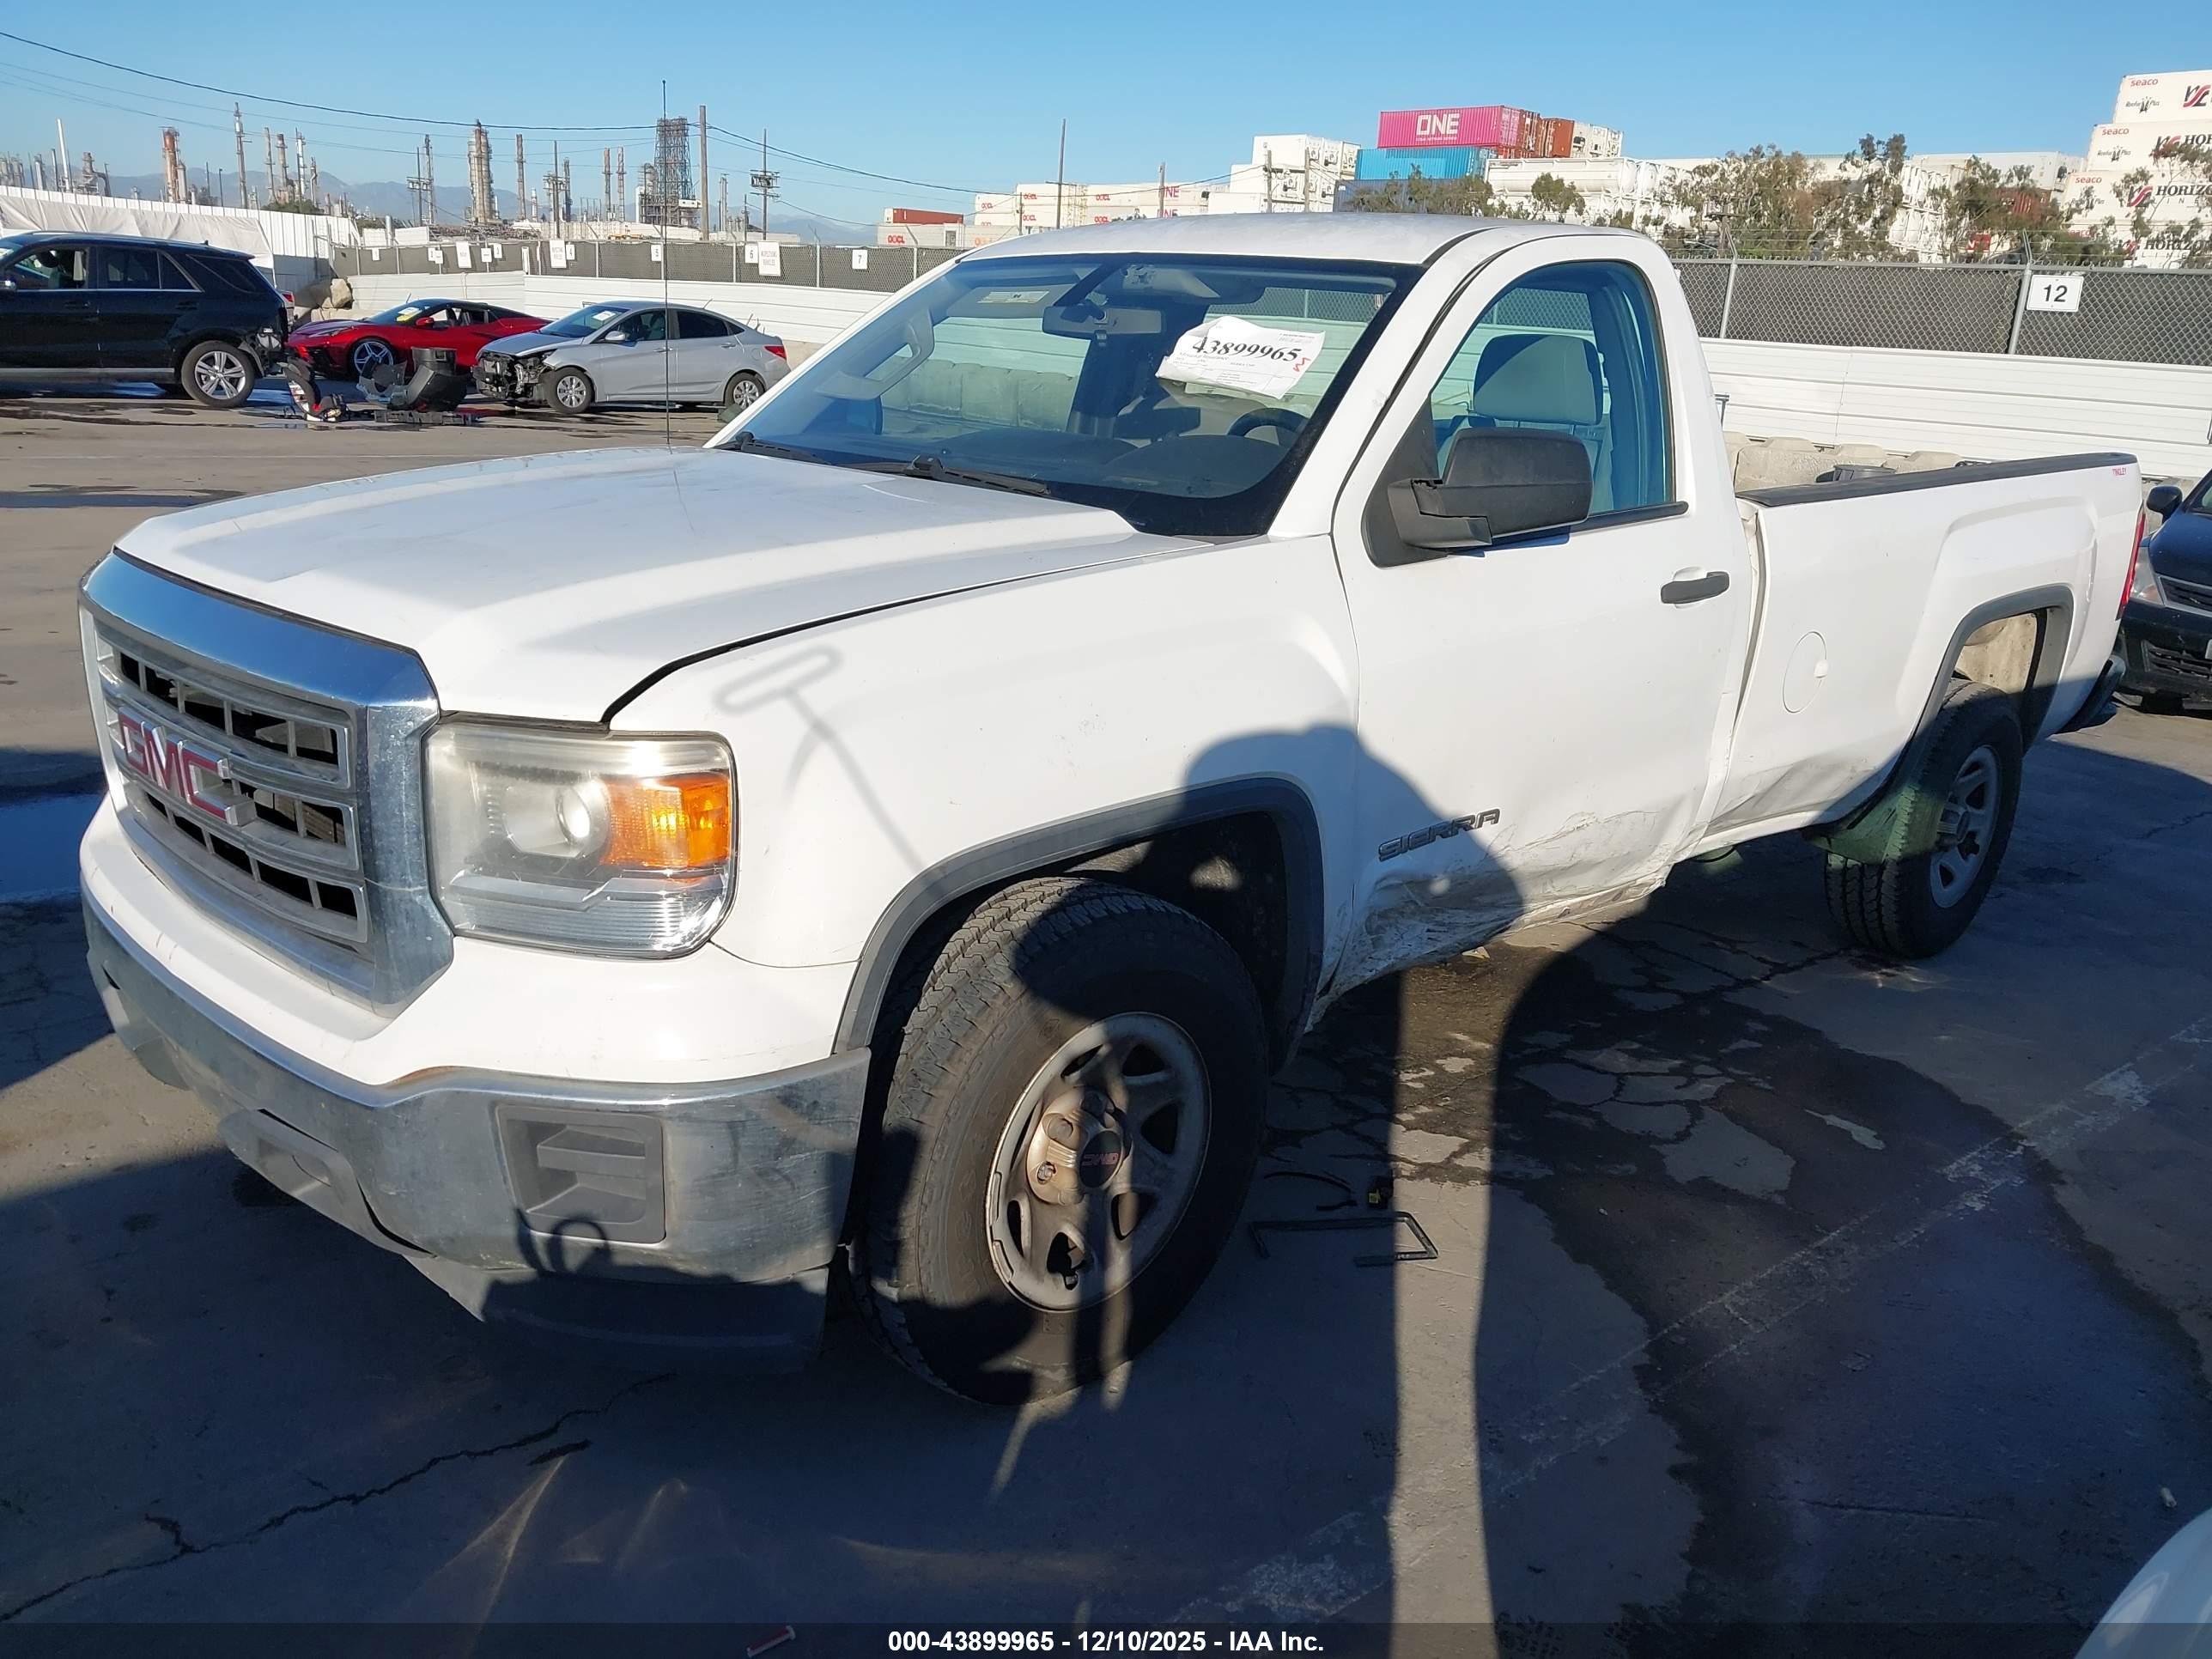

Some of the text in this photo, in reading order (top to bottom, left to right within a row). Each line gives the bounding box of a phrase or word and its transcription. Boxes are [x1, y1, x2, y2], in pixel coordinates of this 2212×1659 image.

[2130, 78, 2159, 87] seaco
[1416, 113, 1460, 136] ONE
[2101, 127, 2130, 136] seaco
[2043, 284, 2069, 303] 12
[1192, 336, 1303, 362] 43899965
[118, 707, 256, 826] GMC
[1378, 807, 1501, 862] SIERRA
